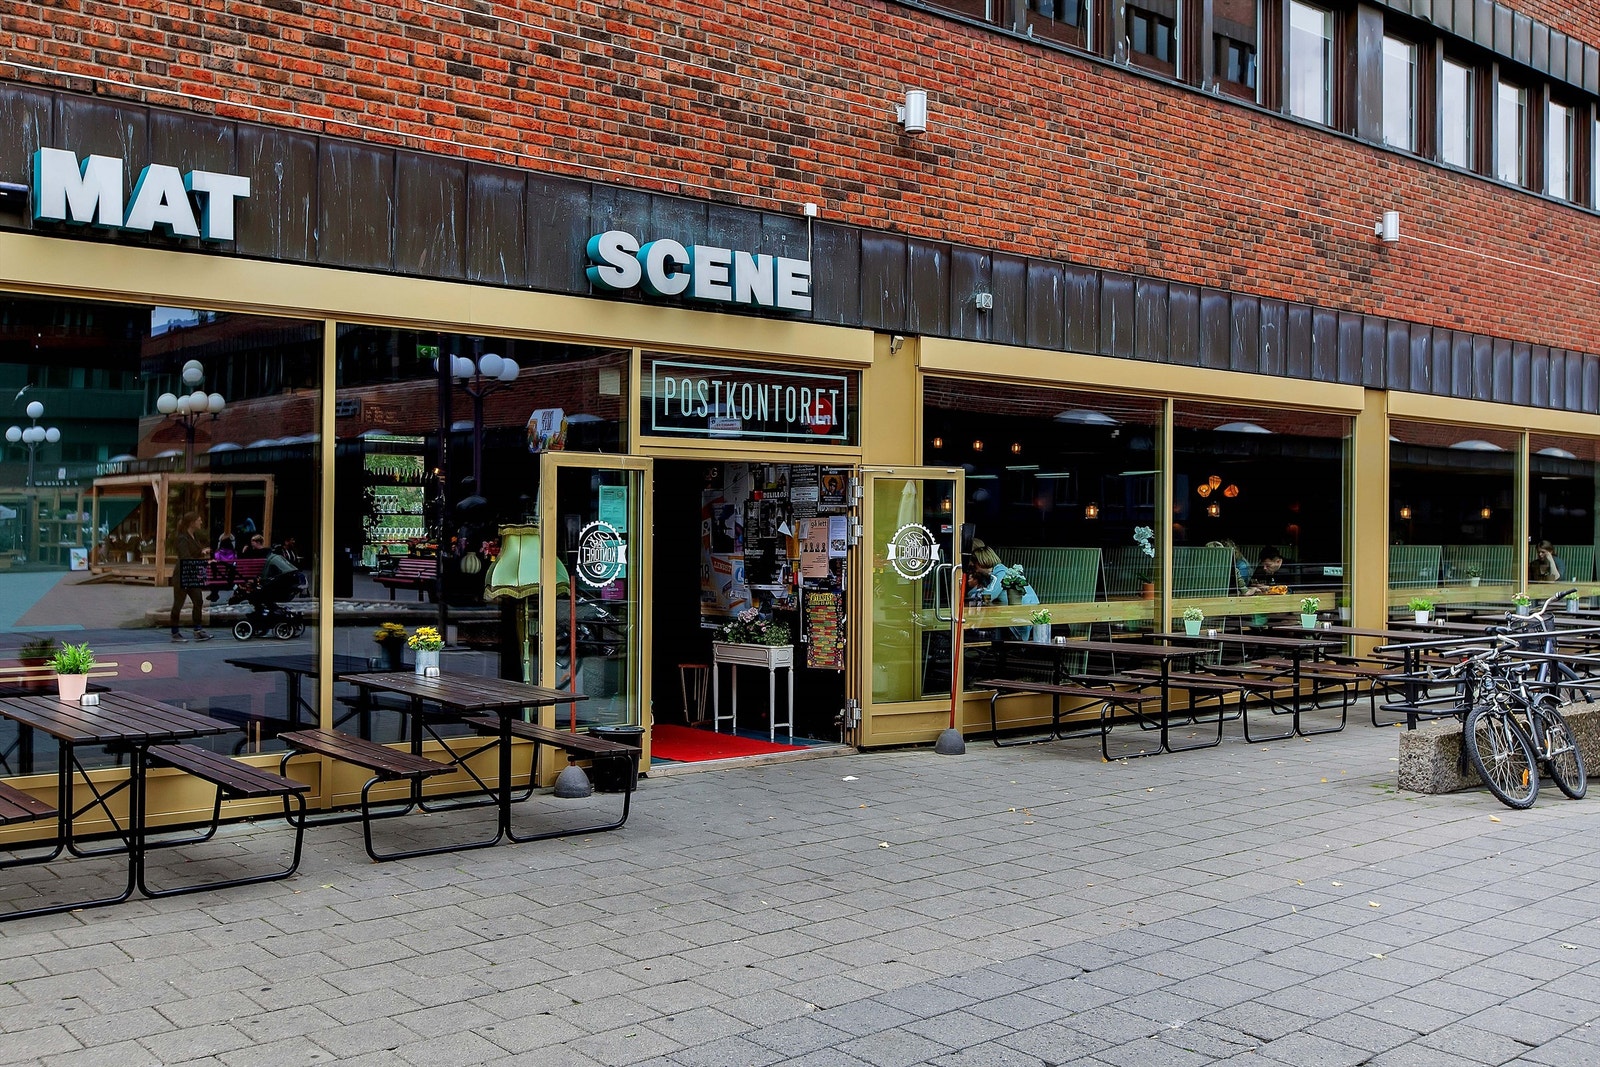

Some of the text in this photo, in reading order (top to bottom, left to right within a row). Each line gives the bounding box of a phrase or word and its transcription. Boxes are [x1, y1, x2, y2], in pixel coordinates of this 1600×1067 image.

[34, 147, 250, 242] MAT
[586, 230, 812, 312] SCENE
[664, 376, 839, 427] POSTKONTORET
